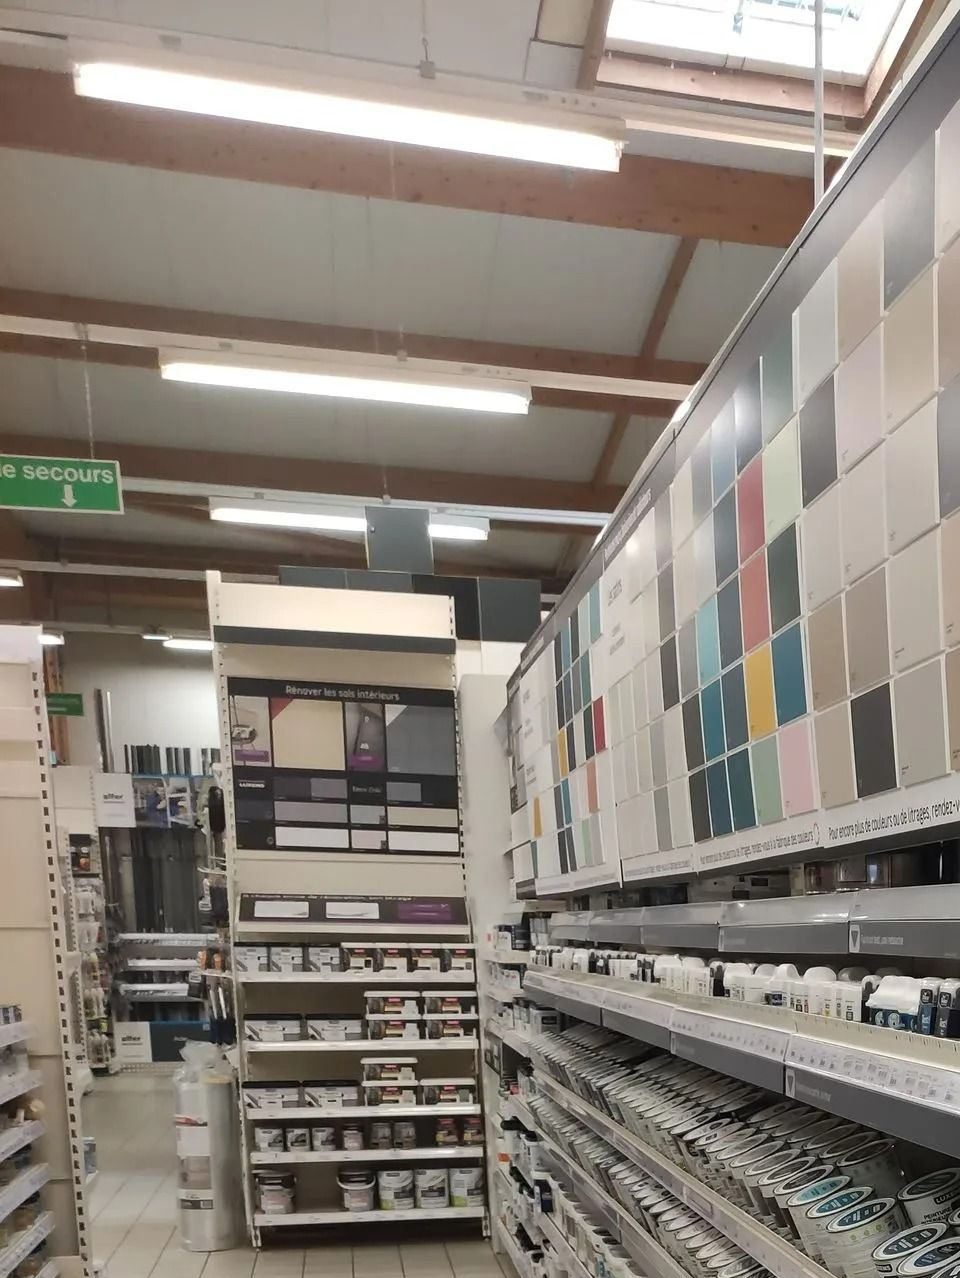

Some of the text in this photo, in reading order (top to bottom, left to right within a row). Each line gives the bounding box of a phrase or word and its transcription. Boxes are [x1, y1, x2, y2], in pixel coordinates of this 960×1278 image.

[0, 463, 114, 484] e secours
[285, 685, 323, 697] Rénover
[324, 688, 337, 697] les
[357, 690, 399, 701] intérieurs
